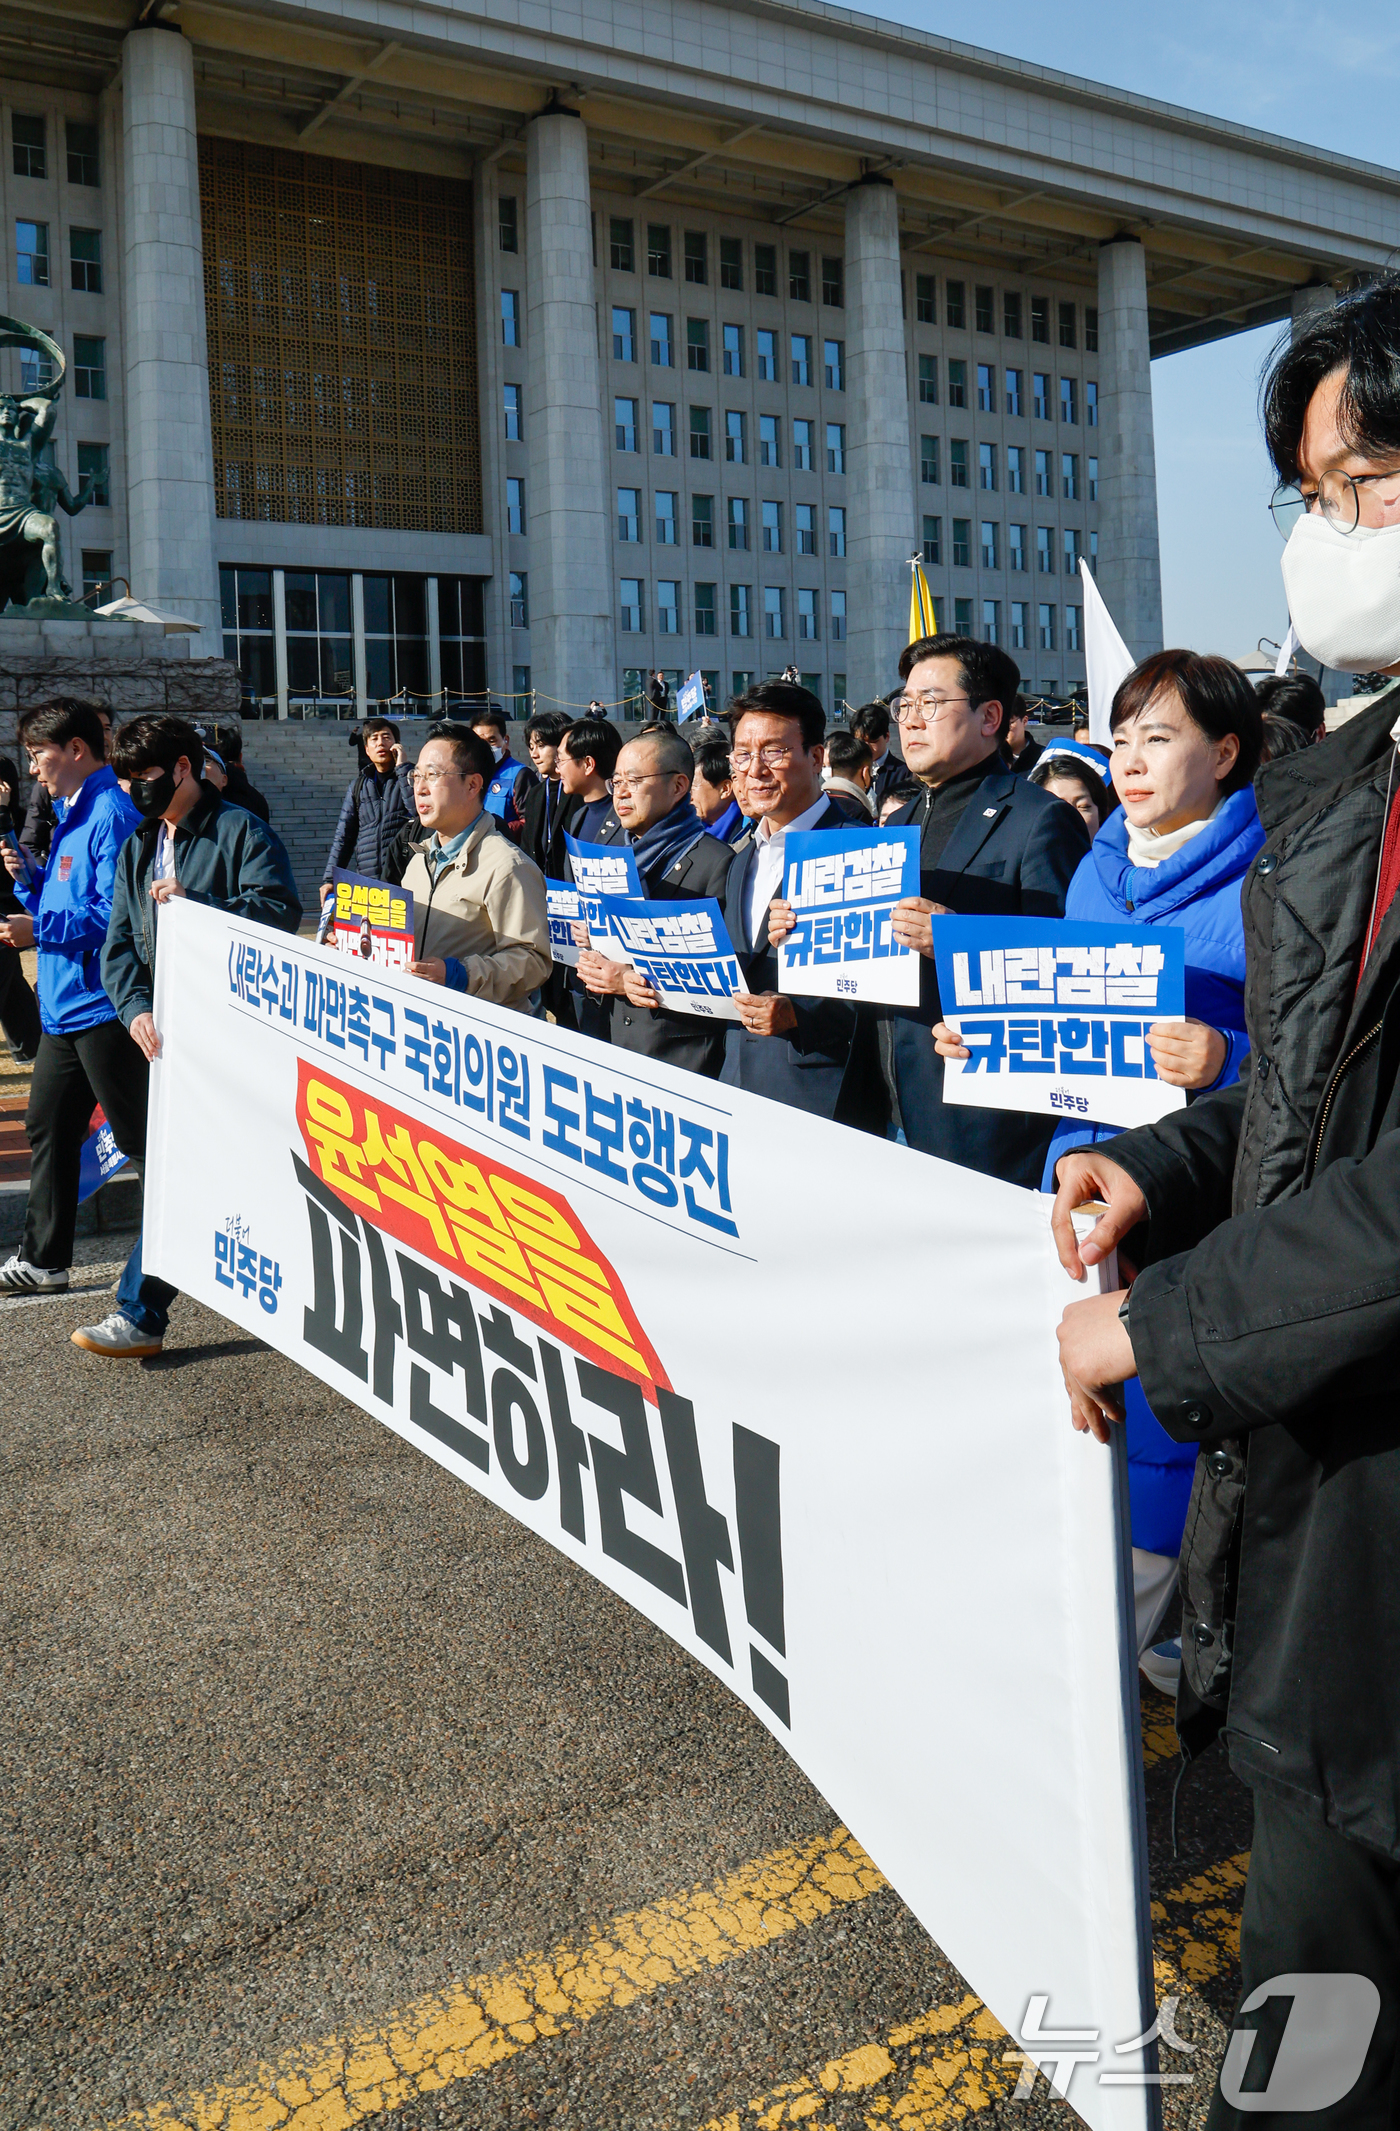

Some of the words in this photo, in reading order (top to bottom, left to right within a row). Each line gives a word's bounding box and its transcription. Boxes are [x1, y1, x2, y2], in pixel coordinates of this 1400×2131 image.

[569, 854, 629, 893] 란검찰
[787, 842, 907, 909] 내란검찰
[336, 882, 407, 930] 윤석열을
[611, 912, 718, 953] 내란검찰
[836, 979, 858, 994] 민주당
[953, 943, 1165, 1007] 내란검찰
[960, 1018, 1163, 1080] 규탄한다
[228, 940, 299, 1027] 내란수괴
[303, 969, 396, 1071] 파면촉구
[404, 1007, 531, 1141] 국회의원
[542, 1064, 740, 1239] 도보행진
[1050, 1092, 1089, 1113] 민주당
[95, 1131, 118, 1163] 민주
[225, 1213, 250, 1245] 더불어
[305, 1078, 653, 1380] 윤석열을
[215, 1230, 283, 1315] 민주당
[289, 1147, 791, 1731] 파면하라!
